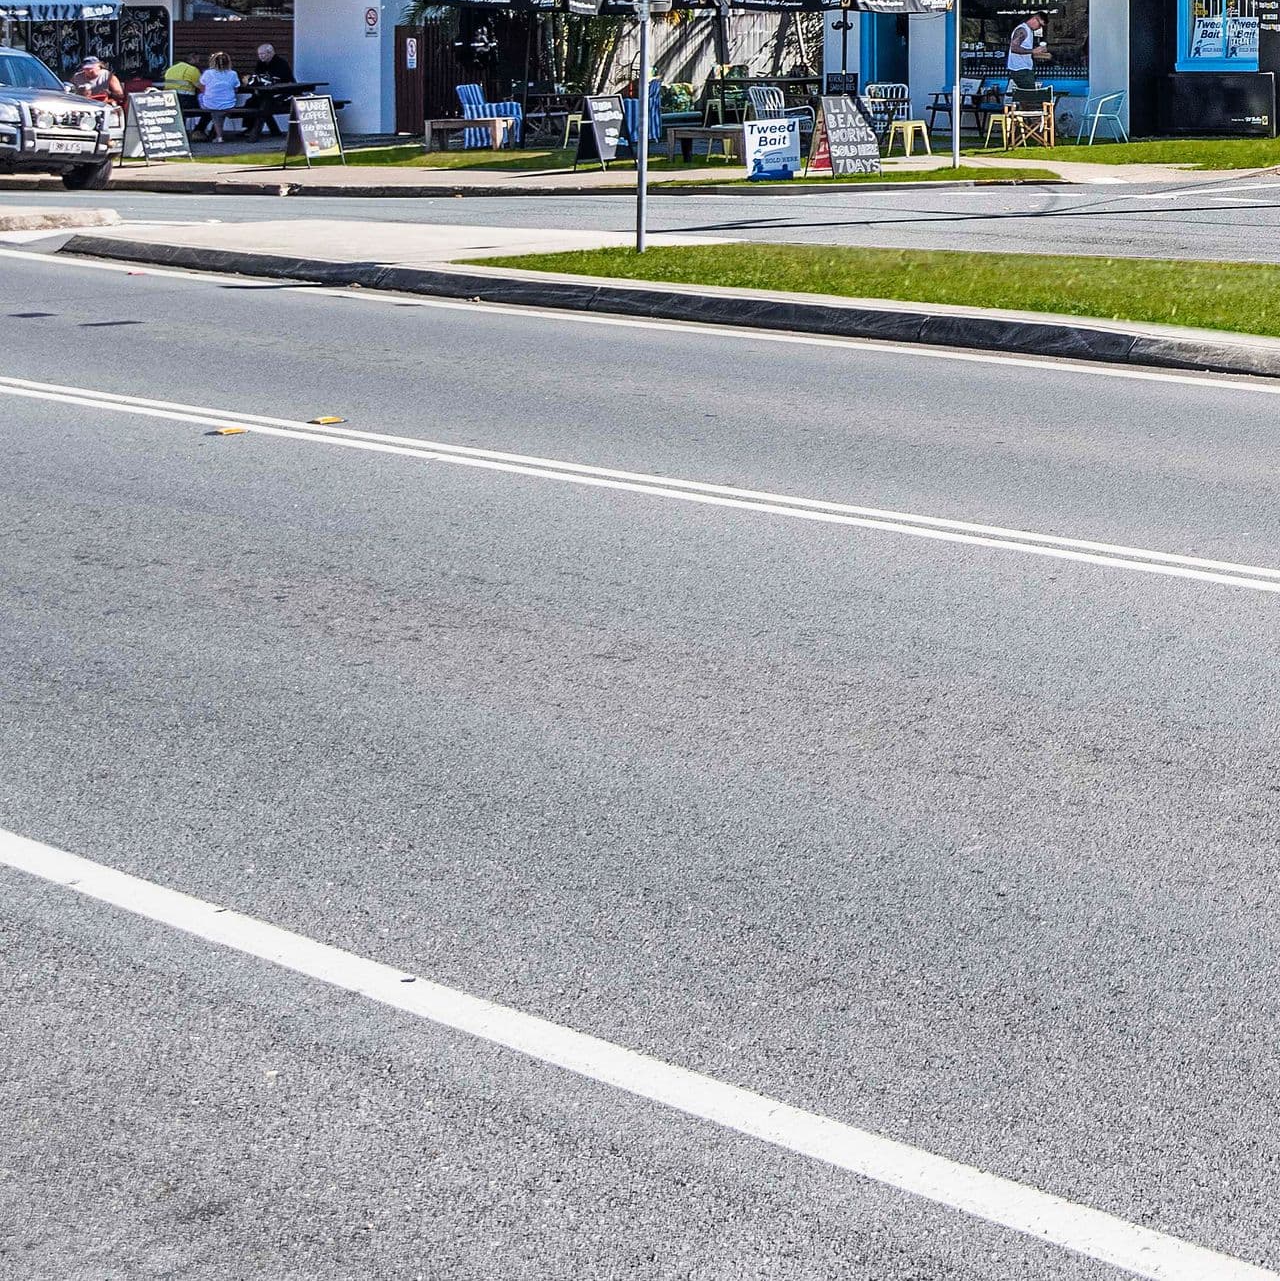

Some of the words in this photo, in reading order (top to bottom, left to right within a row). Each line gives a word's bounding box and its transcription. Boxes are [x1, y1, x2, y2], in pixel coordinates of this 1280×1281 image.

[1197, 20, 1223, 29] Twee
[1200, 30, 1220, 39] Bait
[828, 99, 857, 113] LIV
[748, 121, 796, 135] Tweed
[827, 114, 869, 129] BEAC
[758, 135, 786, 147] Bait
[828, 127, 876, 143] WORMS
[831, 144, 857, 157] SOLD
[765, 156, 781, 165] SOLD
[846, 158, 881, 173] DAYS
